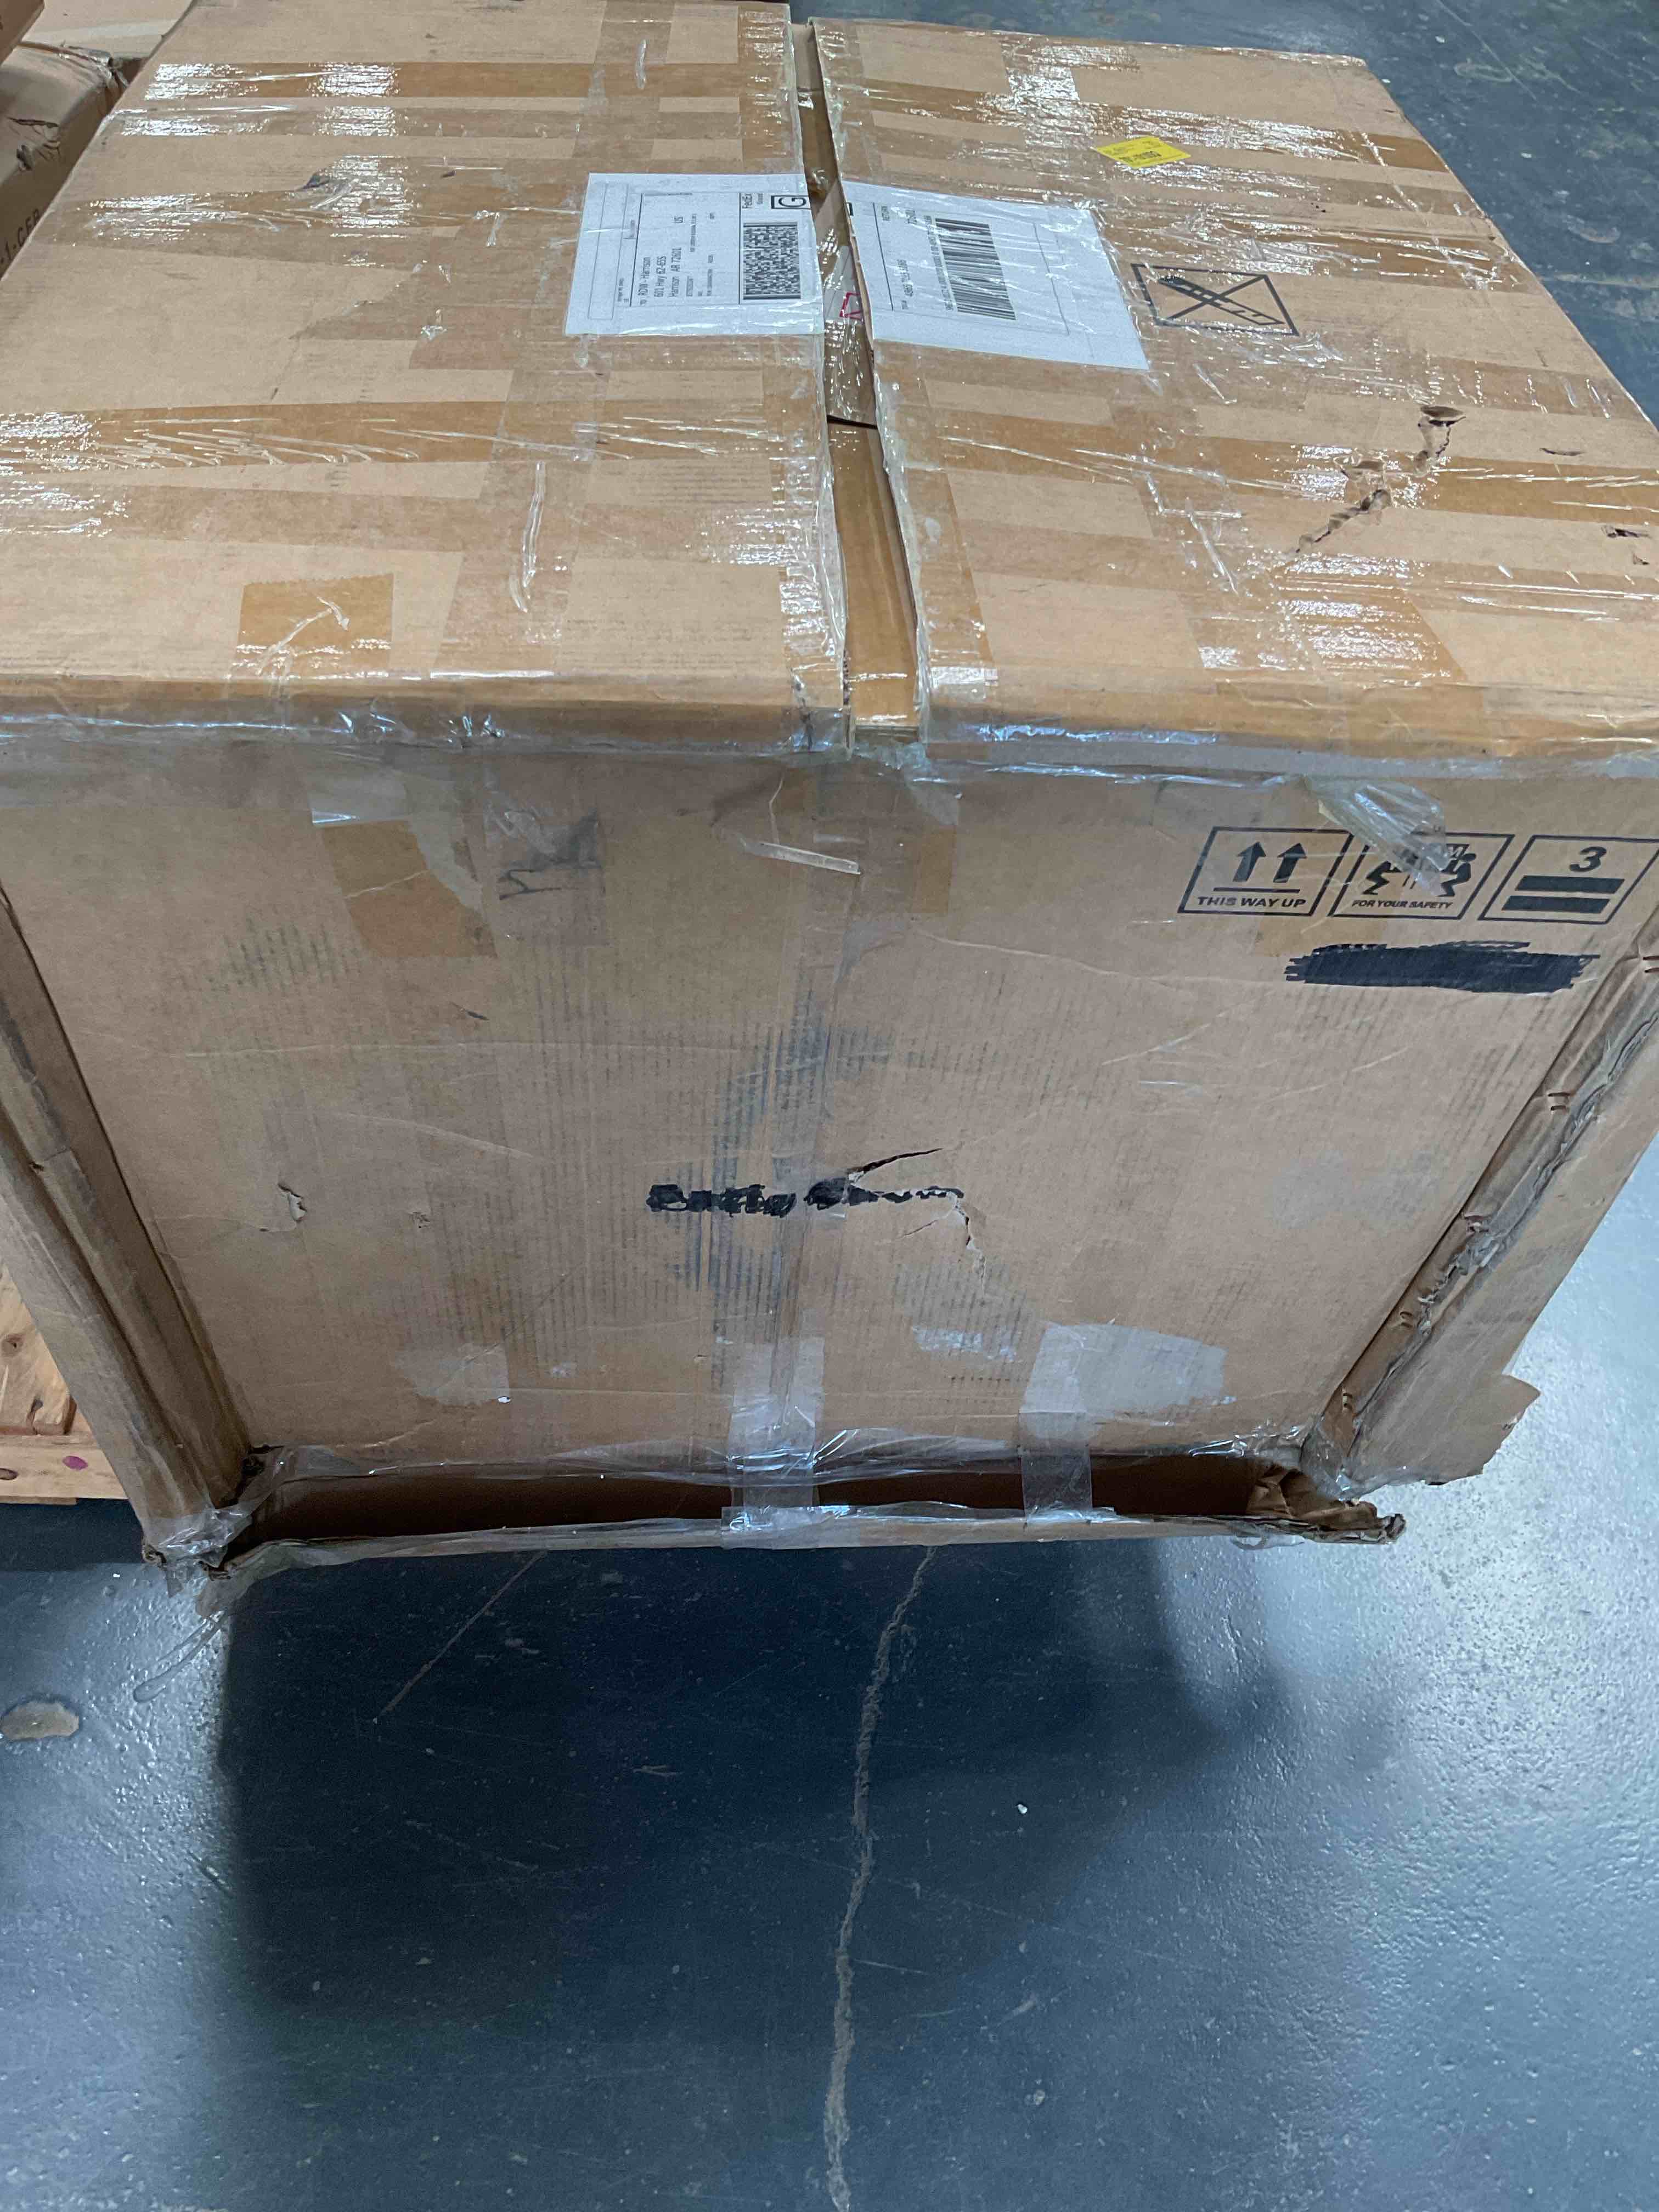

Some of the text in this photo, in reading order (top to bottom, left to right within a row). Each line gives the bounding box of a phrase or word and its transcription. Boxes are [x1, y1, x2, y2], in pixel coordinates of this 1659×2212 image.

[778, 197, 806, 208] G
[671, 247, 682, 263] 72601
[640, 257, 651, 279] Harrison
[670, 264, 681, 273] AR
[654, 256, 667, 297] 601 Hwy 62-65S
[669, 276, 680, 297] Harrison
[1570, 846, 1607, 872] 3
[1198, 896, 1306, 907] THIS WAY UP
[1351, 899, 1375, 907] FOR
